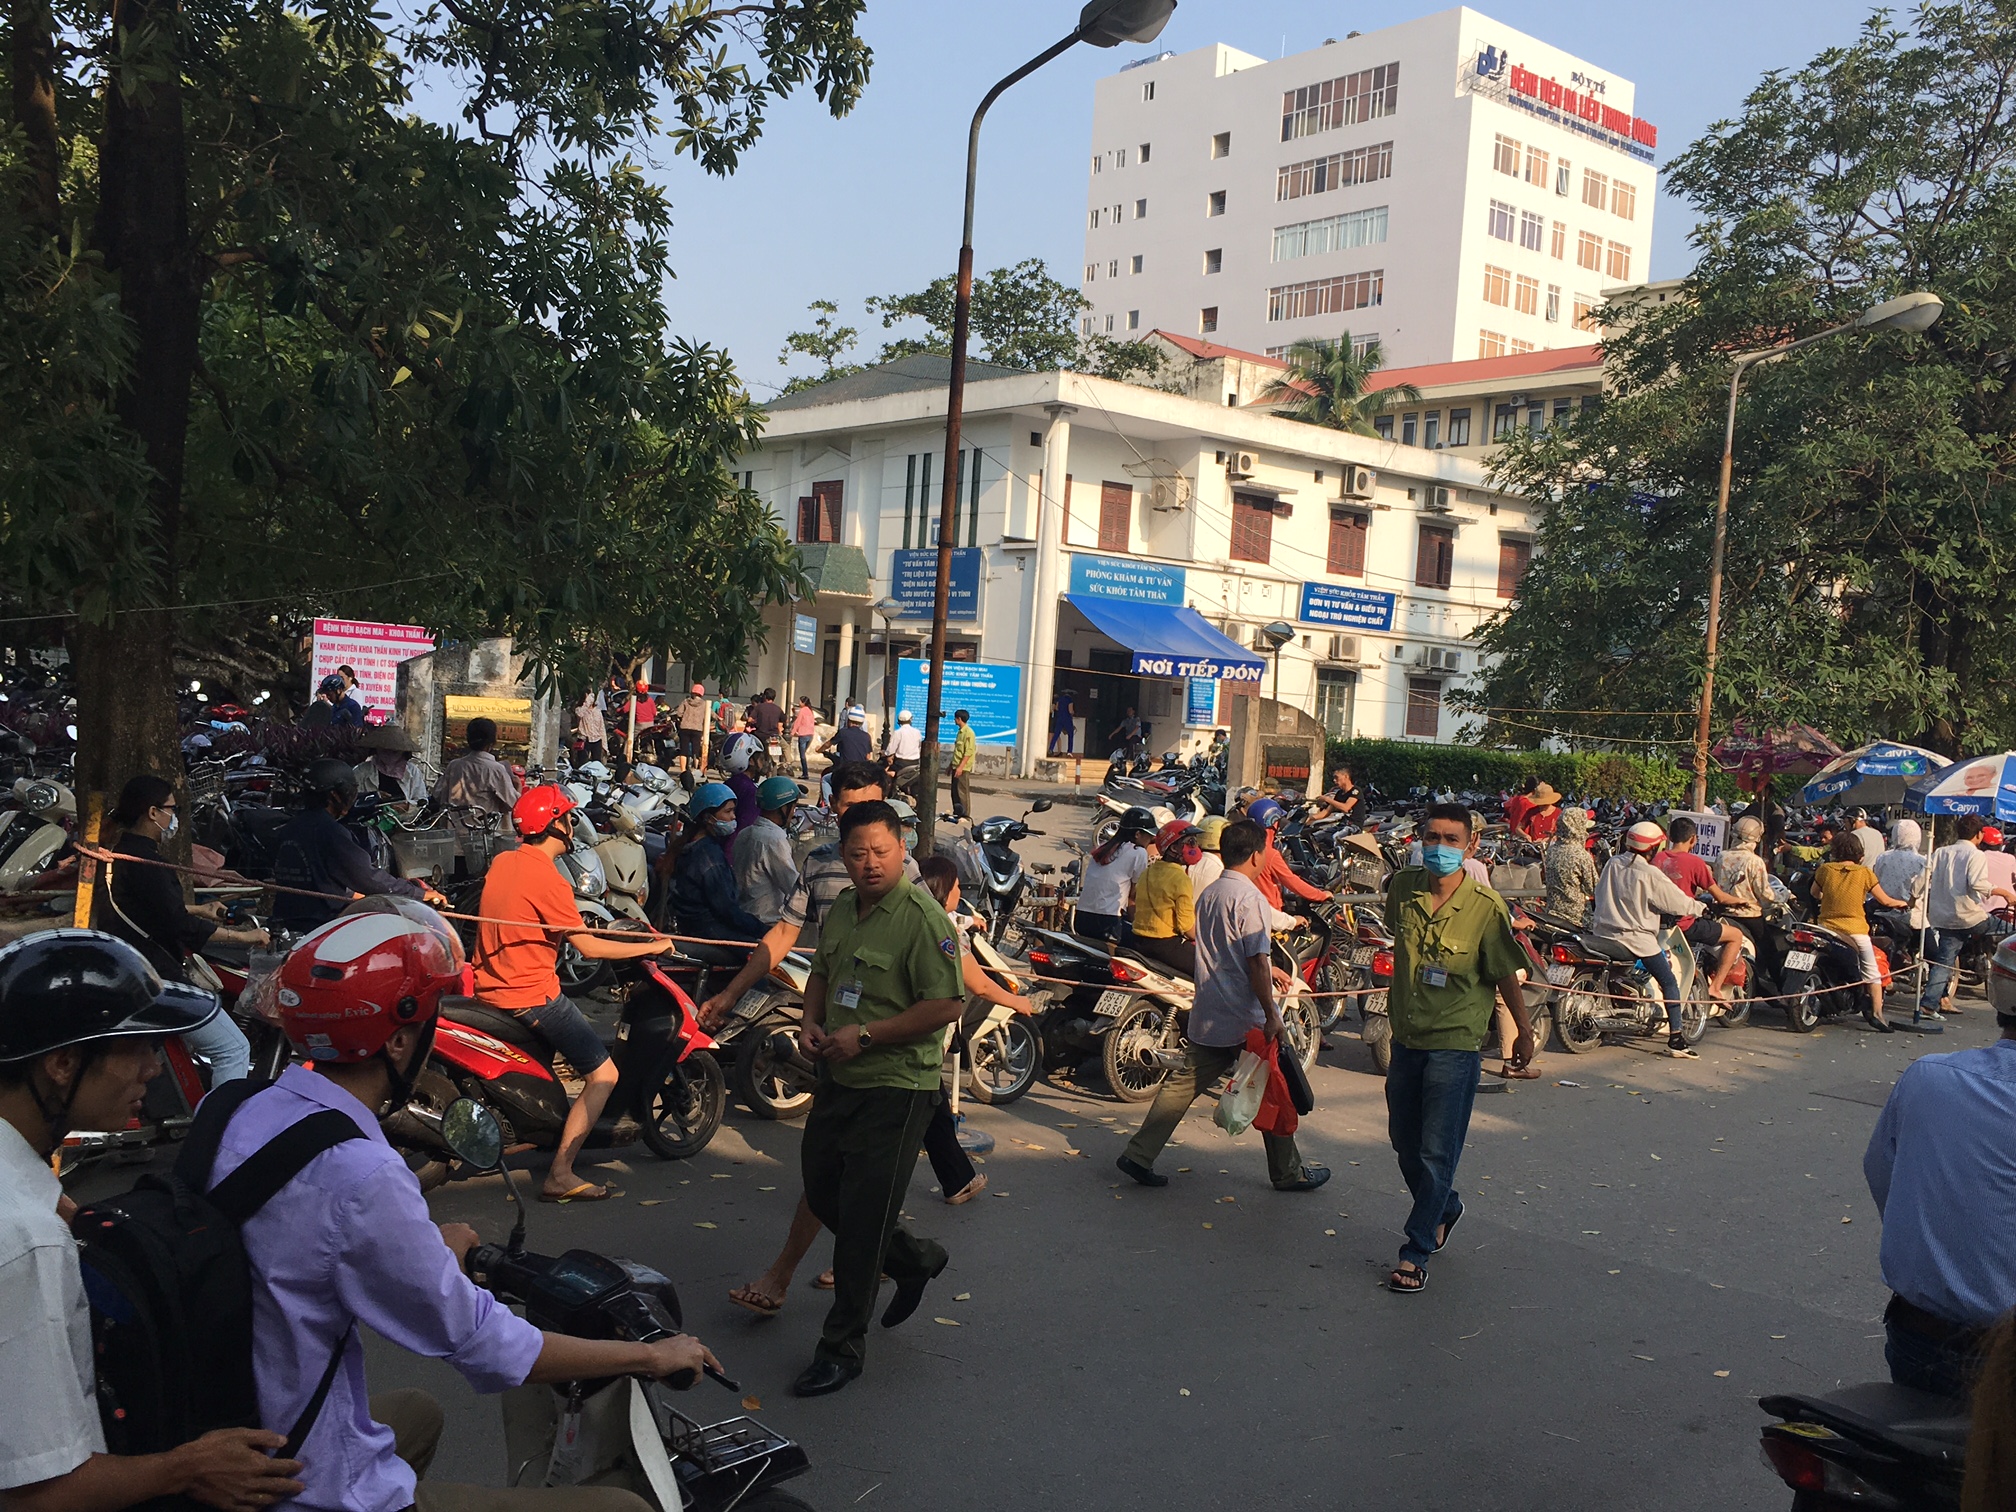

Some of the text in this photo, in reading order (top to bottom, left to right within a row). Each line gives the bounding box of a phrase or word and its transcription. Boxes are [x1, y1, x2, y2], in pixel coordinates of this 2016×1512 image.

[1571, 71, 1606, 94] BỘ Y TẾ
[1510, 63, 1539, 98] BỆNH
[1540, 76, 1564, 110] VIỆN
[1564, 88, 1577, 115] DA
[1602, 104, 1632, 138] TRUNG
[1085, 569, 1113, 580] PHÒNG
[1113, 571, 1137, 584] KHÁM
[1137, 576, 1144, 585] &
[1089, 583, 1105, 593] SỨC
[1128, 587, 1146, 598] TÂM
[1354, 604, 1360, 612] &
[323, 622, 340, 633] BỆNH
[340, 624, 354, 635] VIỆN
[355, 626, 372, 637] BẠCH
[373, 628, 384, 636] MAI
[389, 629, 405, 638] KHOA
[358, 645, 373, 653] KHOA
[388, 648, 401, 656] KINH
[1138, 658, 1261, 681] NƠI TIẾP ĐÓN
[1824, 779, 1852, 793] Caryn
[1949, 801, 1980, 814] Caryn
[1700, 822, 1717, 839] VIỆN
[344, 1006, 370, 1017] Evic
